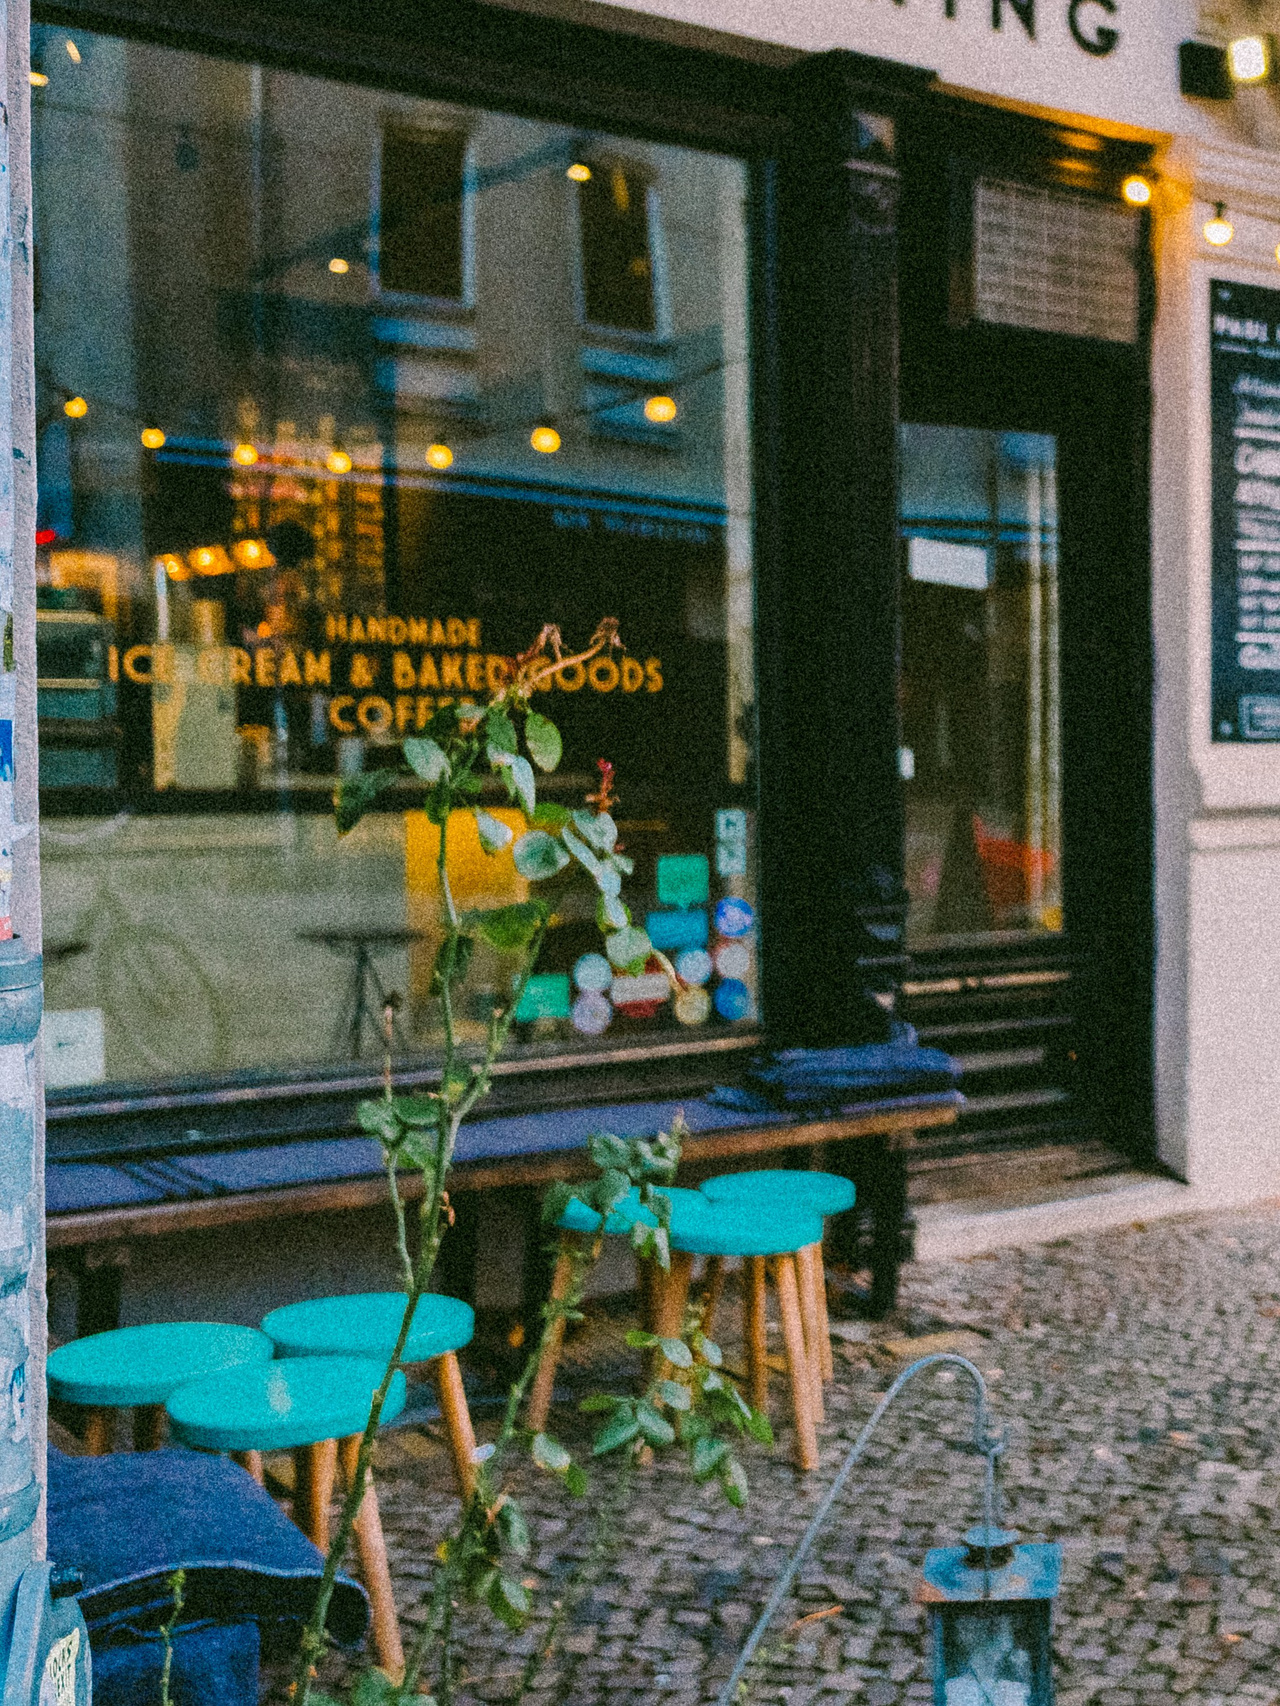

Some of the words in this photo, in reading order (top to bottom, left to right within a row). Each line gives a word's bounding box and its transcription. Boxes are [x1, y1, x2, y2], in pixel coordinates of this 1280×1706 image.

[325, 613, 481, 647] HANDMADE
[350, 652, 376, 689] &
[392, 652, 515, 693] BAKED
[517, 655, 663, 694] GOODS
[329, 695, 478, 734] COFF
